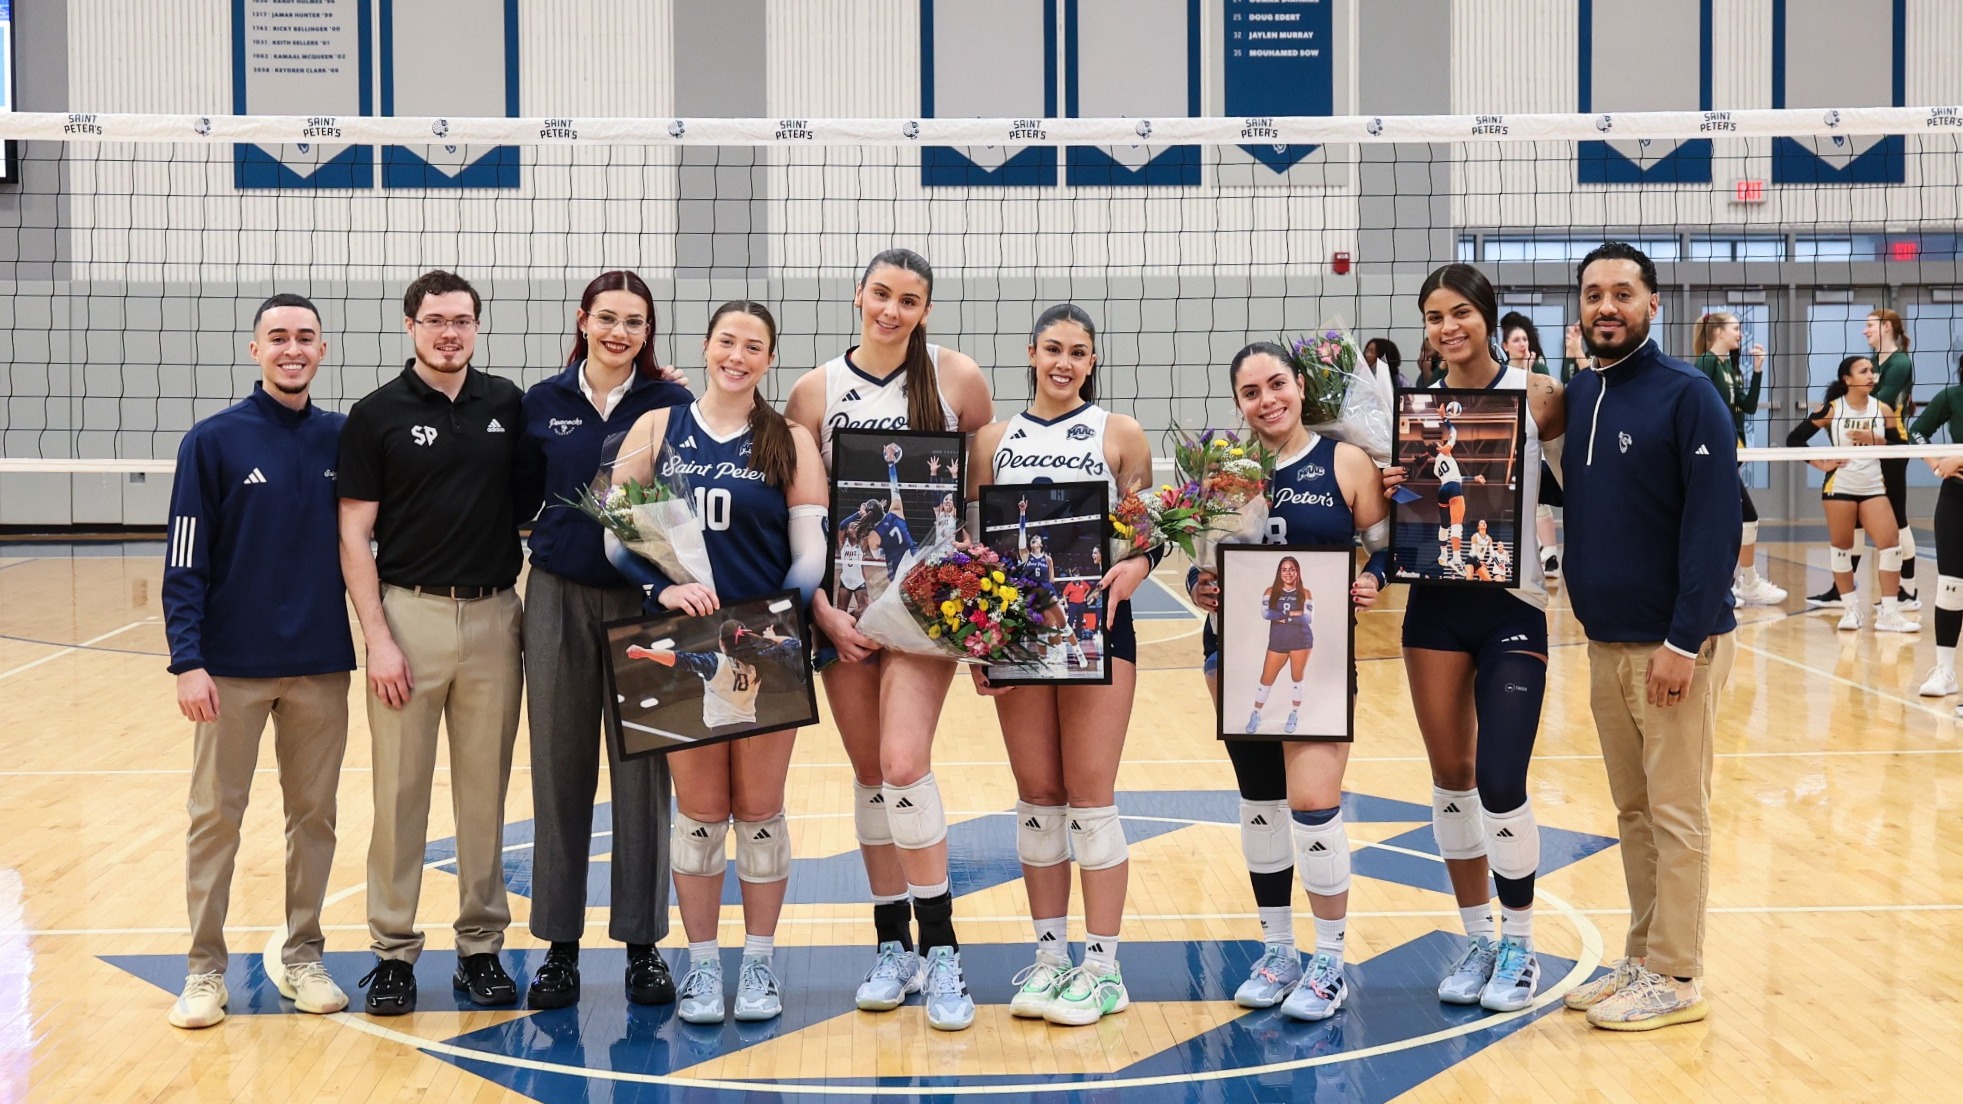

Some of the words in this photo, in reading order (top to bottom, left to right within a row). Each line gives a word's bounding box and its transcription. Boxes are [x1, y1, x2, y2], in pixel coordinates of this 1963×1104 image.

[1249, 13, 1273, 21] DOUG
[1275, 13, 1301, 21] EDERT
[1233, 31, 1242, 39] 32
[1248, 31, 1278, 40] JAYLEN
[1279, 31, 1314, 39] MURRAY
[1249, 49, 1298, 57] MOUHAMED
[1299, 49, 1320, 57] SOW
[1704, 112, 1732, 122] SAINT
[1930, 107, 1958, 117] SAINT
[68, 114, 97, 123] SAINT
[307, 117, 336, 127] SAINT
[544, 119, 573, 128] SAINT
[779, 119, 808, 129] SAINT
[1013, 119, 1042, 129] SAINT
[1245, 118, 1274, 128] SAINT
[1475, 115, 1503, 125] SAINT
[1926, 116, 1963, 127] PETER'S
[64, 123, 102, 135] PETER'S
[1472, 125, 1508, 135] PETER'S
[1700, 121, 1737, 132] PETER'S
[303, 127, 341, 138] PETER'S
[540, 128, 578, 139] PETER'S
[775, 129, 813, 140] PETER'S
[1009, 129, 1047, 140] PETER'S
[1241, 128, 1278, 138] PETER'S
[1737, 181, 1763, 200] EXIT
[411, 425, 438, 446] SP
[1066, 427, 1097, 440] MAAC
[660, 455, 714, 477] Saint
[994, 447, 1104, 479] Peacocks
[1274, 487, 1334, 509] Peter's
[694, 486, 732, 531] 10
[889, 526, 903, 545] 7
[1035, 567, 1041, 577] 6
[730, 668, 749, 692] 10
